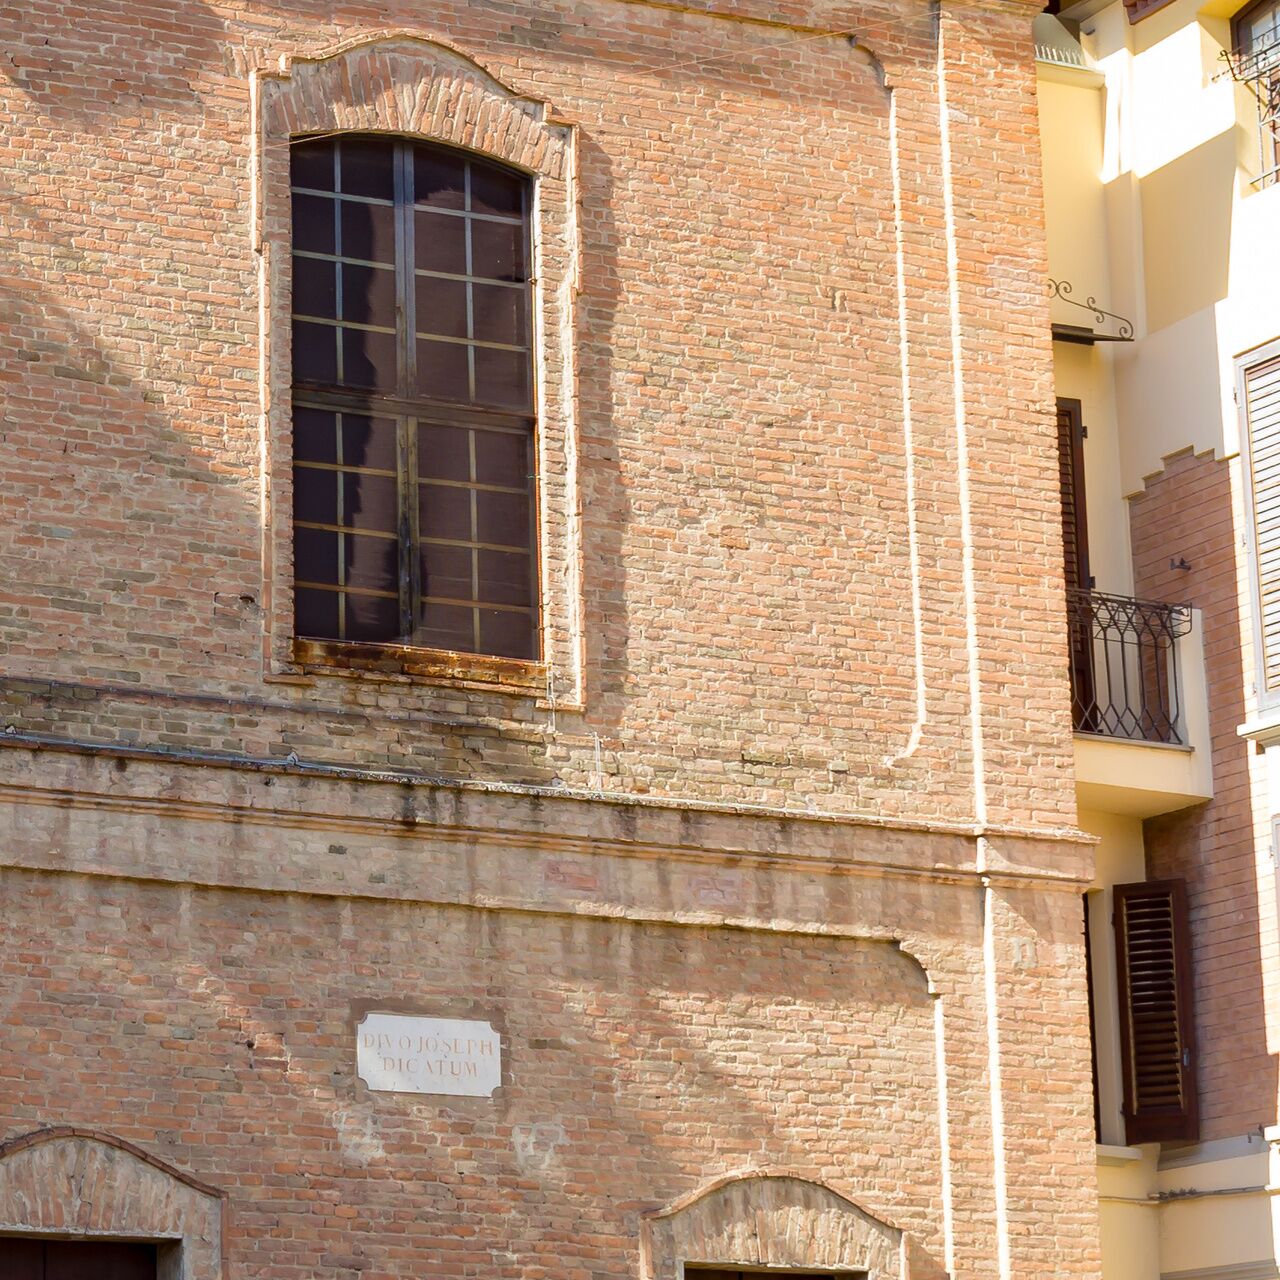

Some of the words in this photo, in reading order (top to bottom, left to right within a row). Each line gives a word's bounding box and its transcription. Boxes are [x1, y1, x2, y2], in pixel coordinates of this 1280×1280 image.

[363, 1032, 411, 1050] DIVO
[417, 1035, 494, 1056] JOSEPH
[382, 1056, 479, 1078] DICATUM
